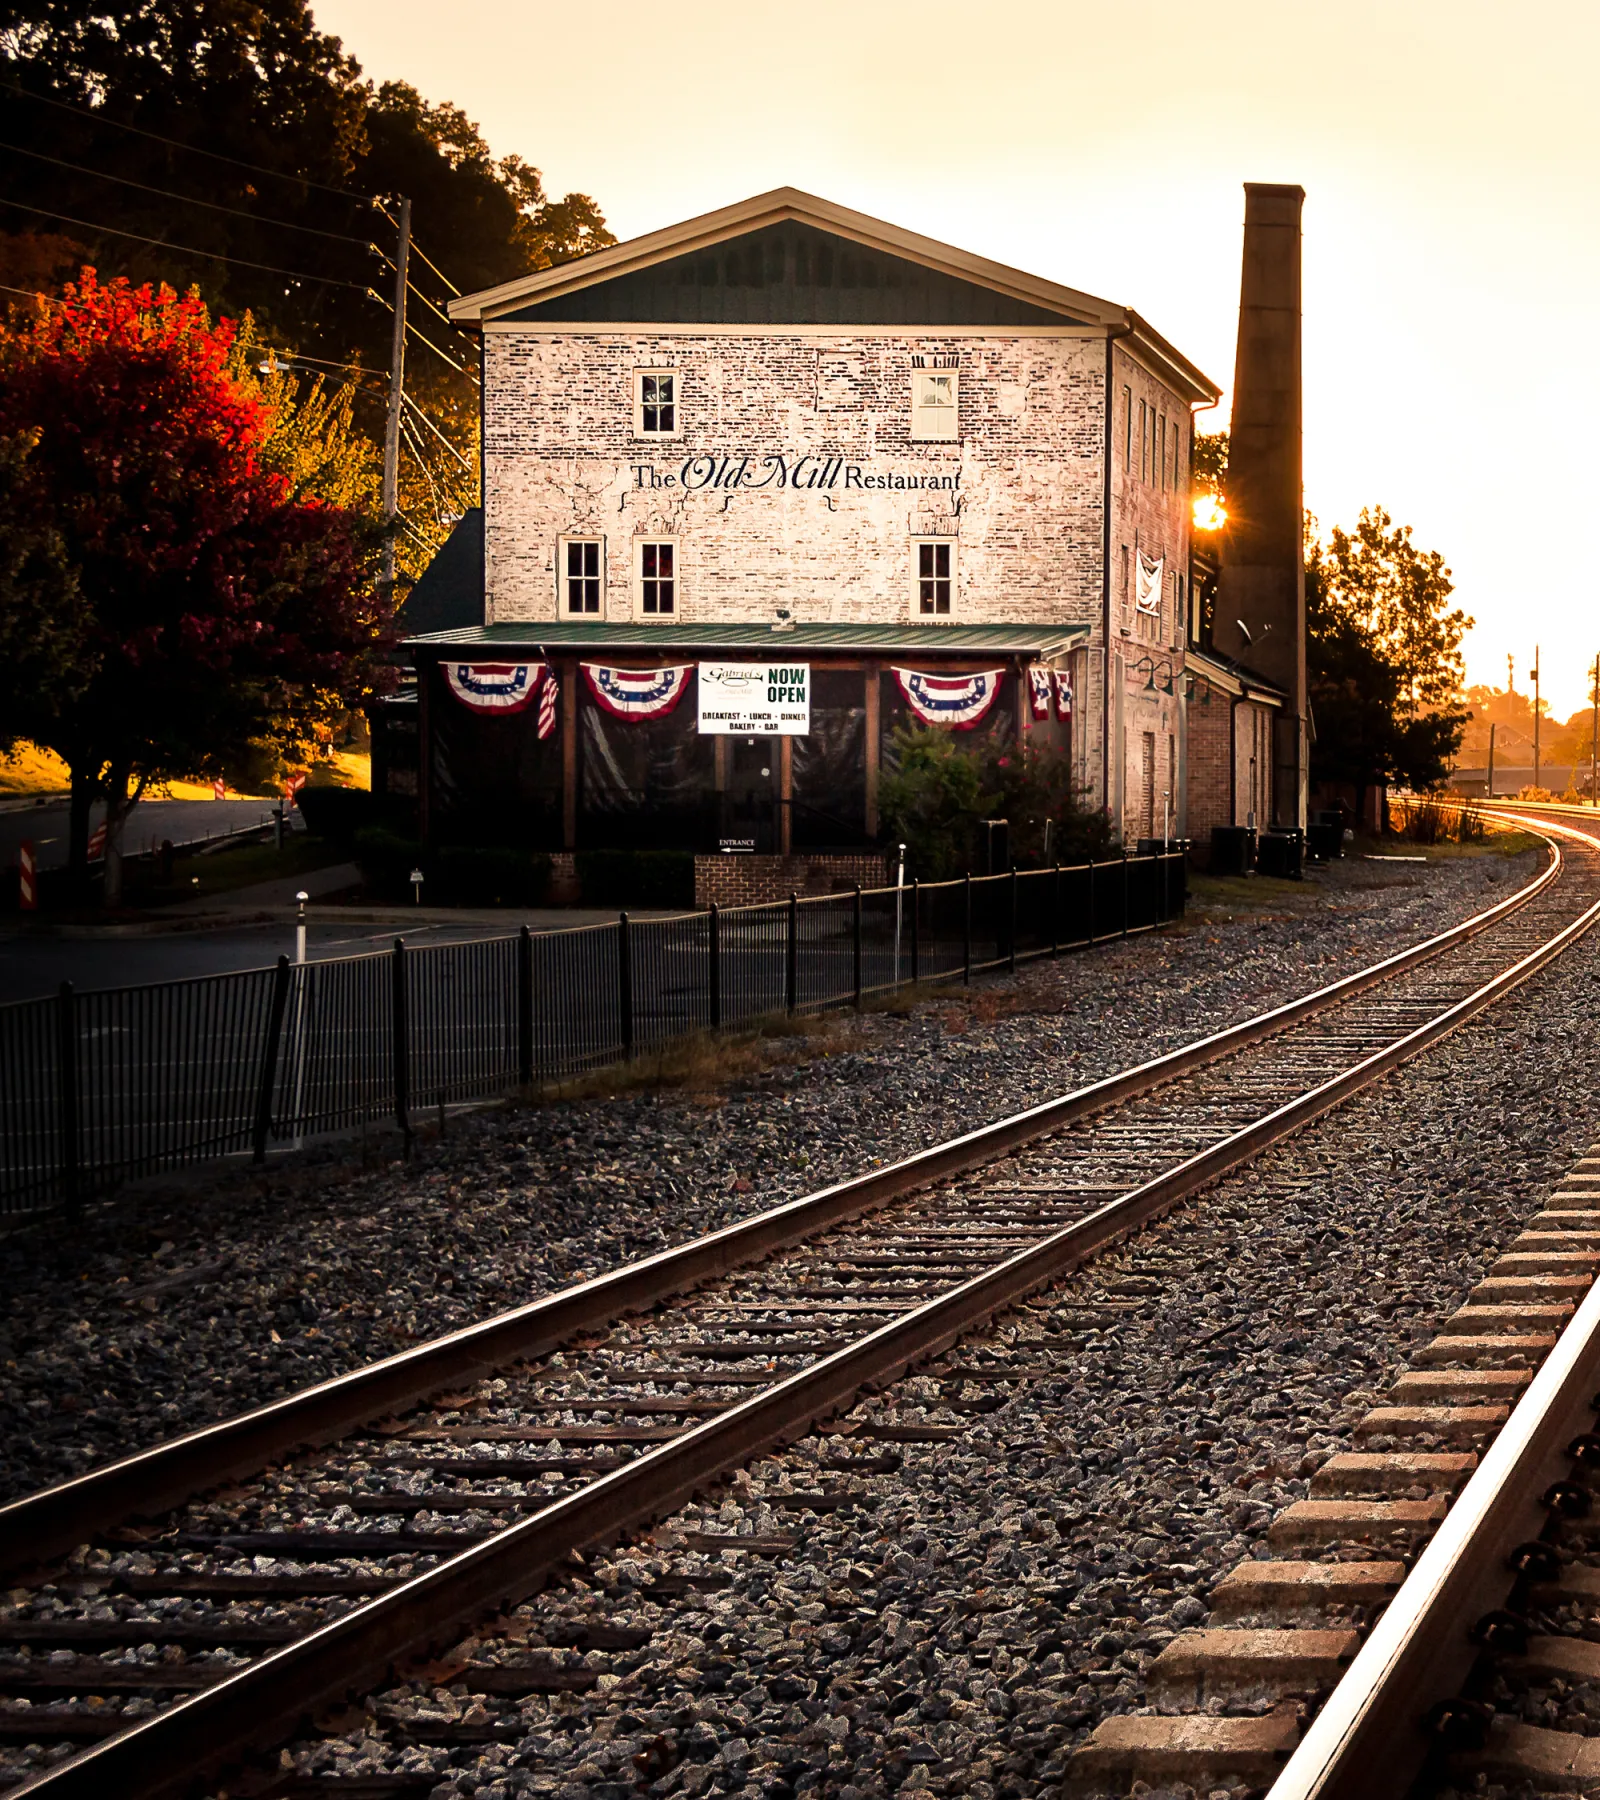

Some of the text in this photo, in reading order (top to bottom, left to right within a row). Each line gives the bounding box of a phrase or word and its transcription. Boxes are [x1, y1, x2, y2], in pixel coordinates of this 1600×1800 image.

[630, 454, 961, 490] The Old Mill Restaurant
[768, 668, 805, 685] NOW
[767, 686, 805, 702] OPEN
[702, 712, 806, 721] BREAKFAST LUNCH DINNER
[729, 722, 779, 731] BAKERY BAR
